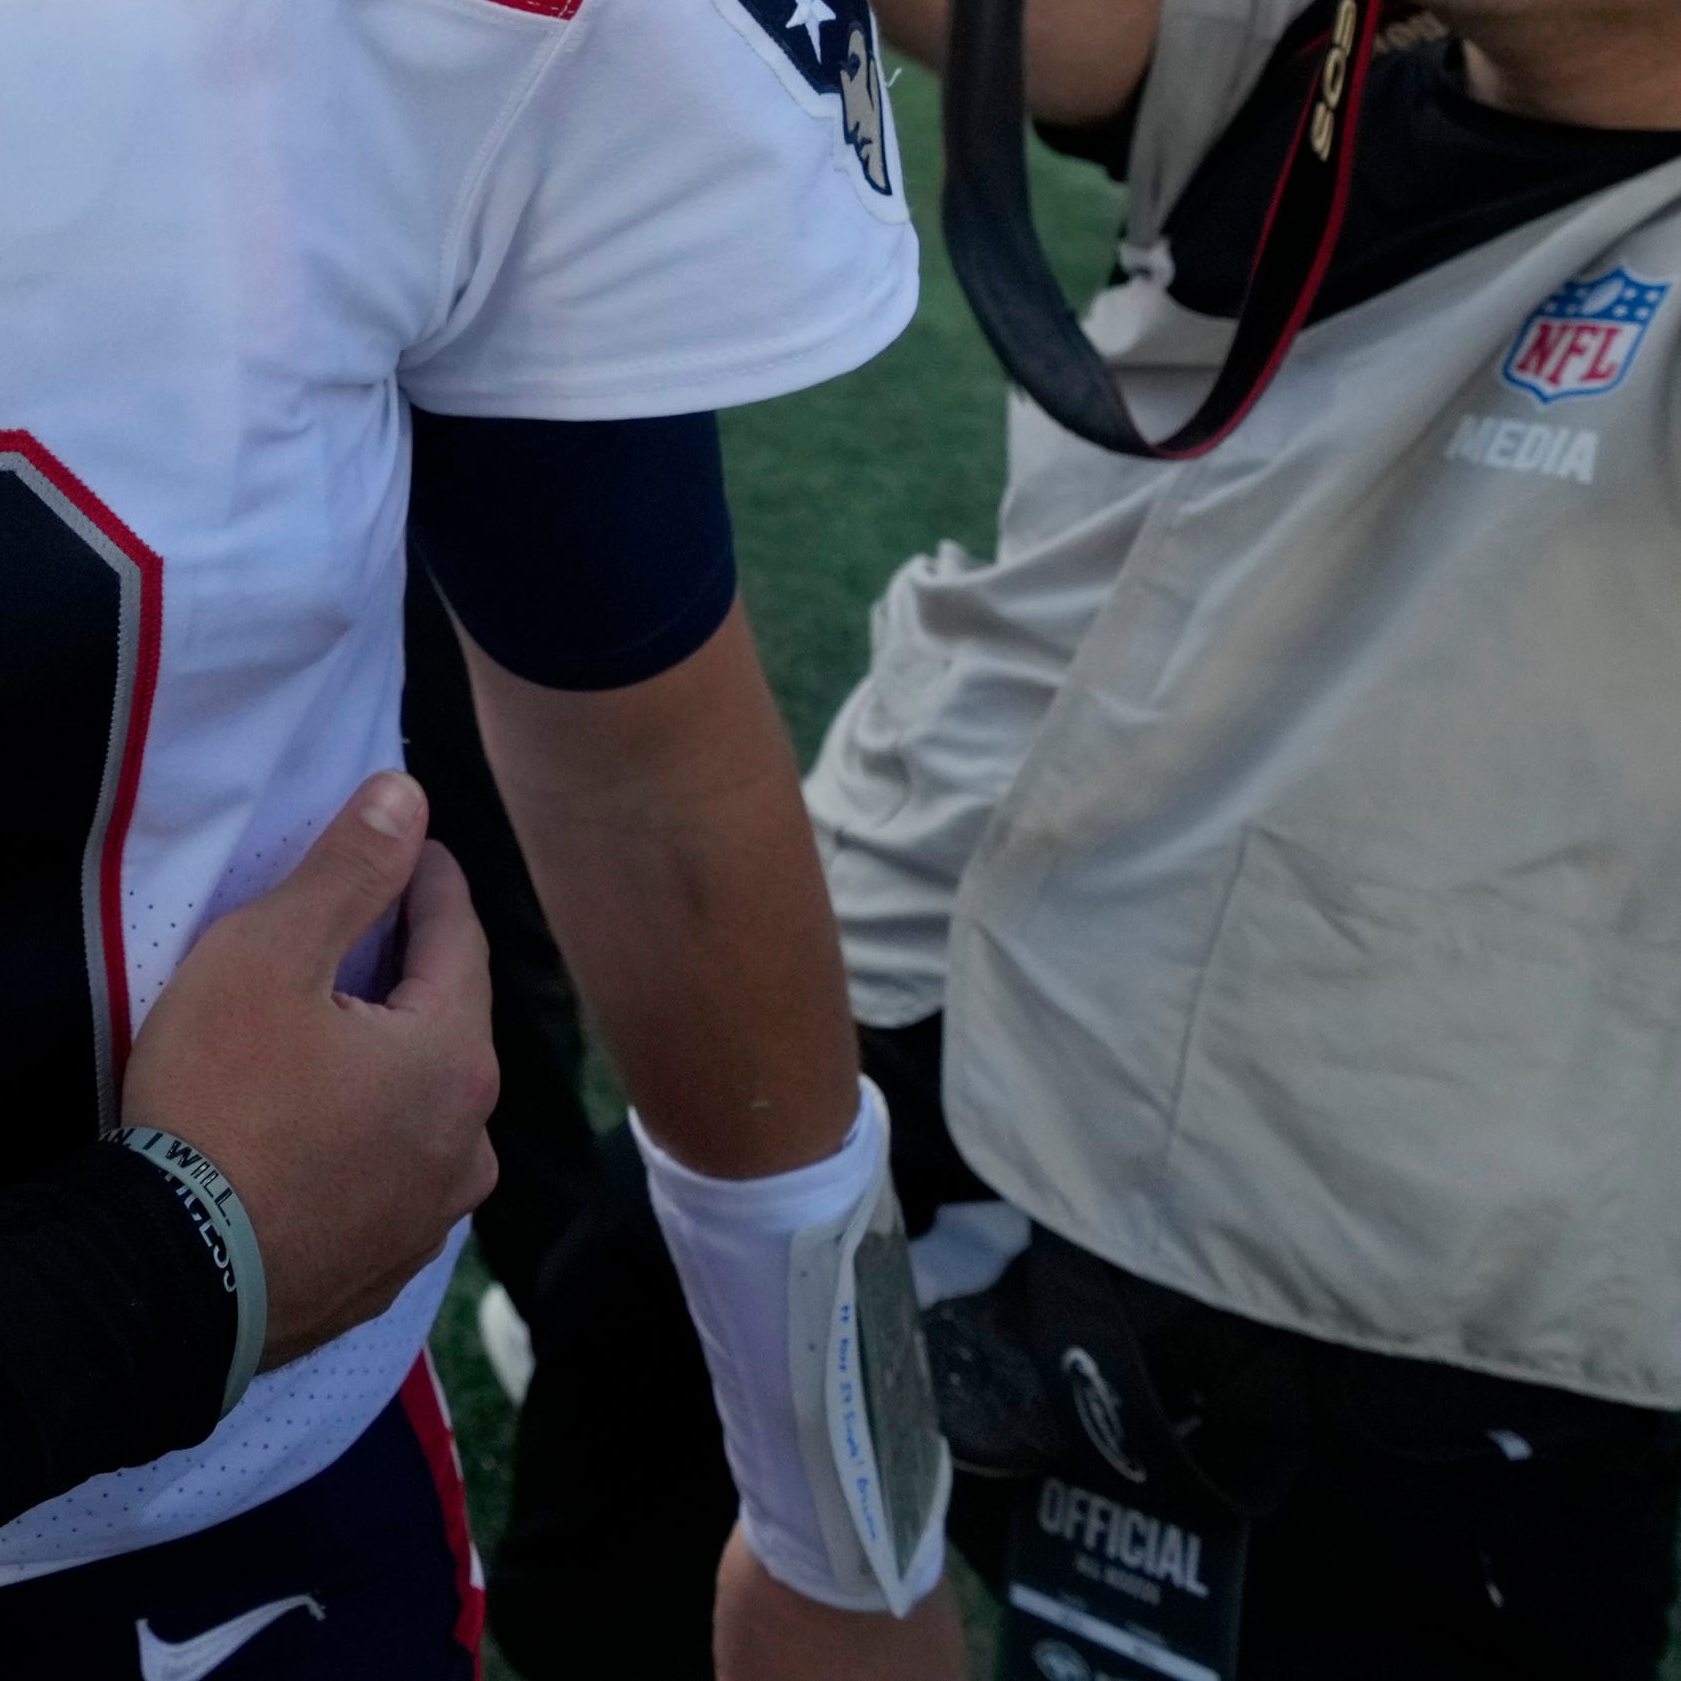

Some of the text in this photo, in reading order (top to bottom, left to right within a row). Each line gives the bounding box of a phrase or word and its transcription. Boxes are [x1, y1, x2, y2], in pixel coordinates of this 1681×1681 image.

[1515, 322, 1622, 386] NFL
[1445, 414, 1600, 485] MEDIA
[1039, 1476, 1210, 1599] OFFICIAL
